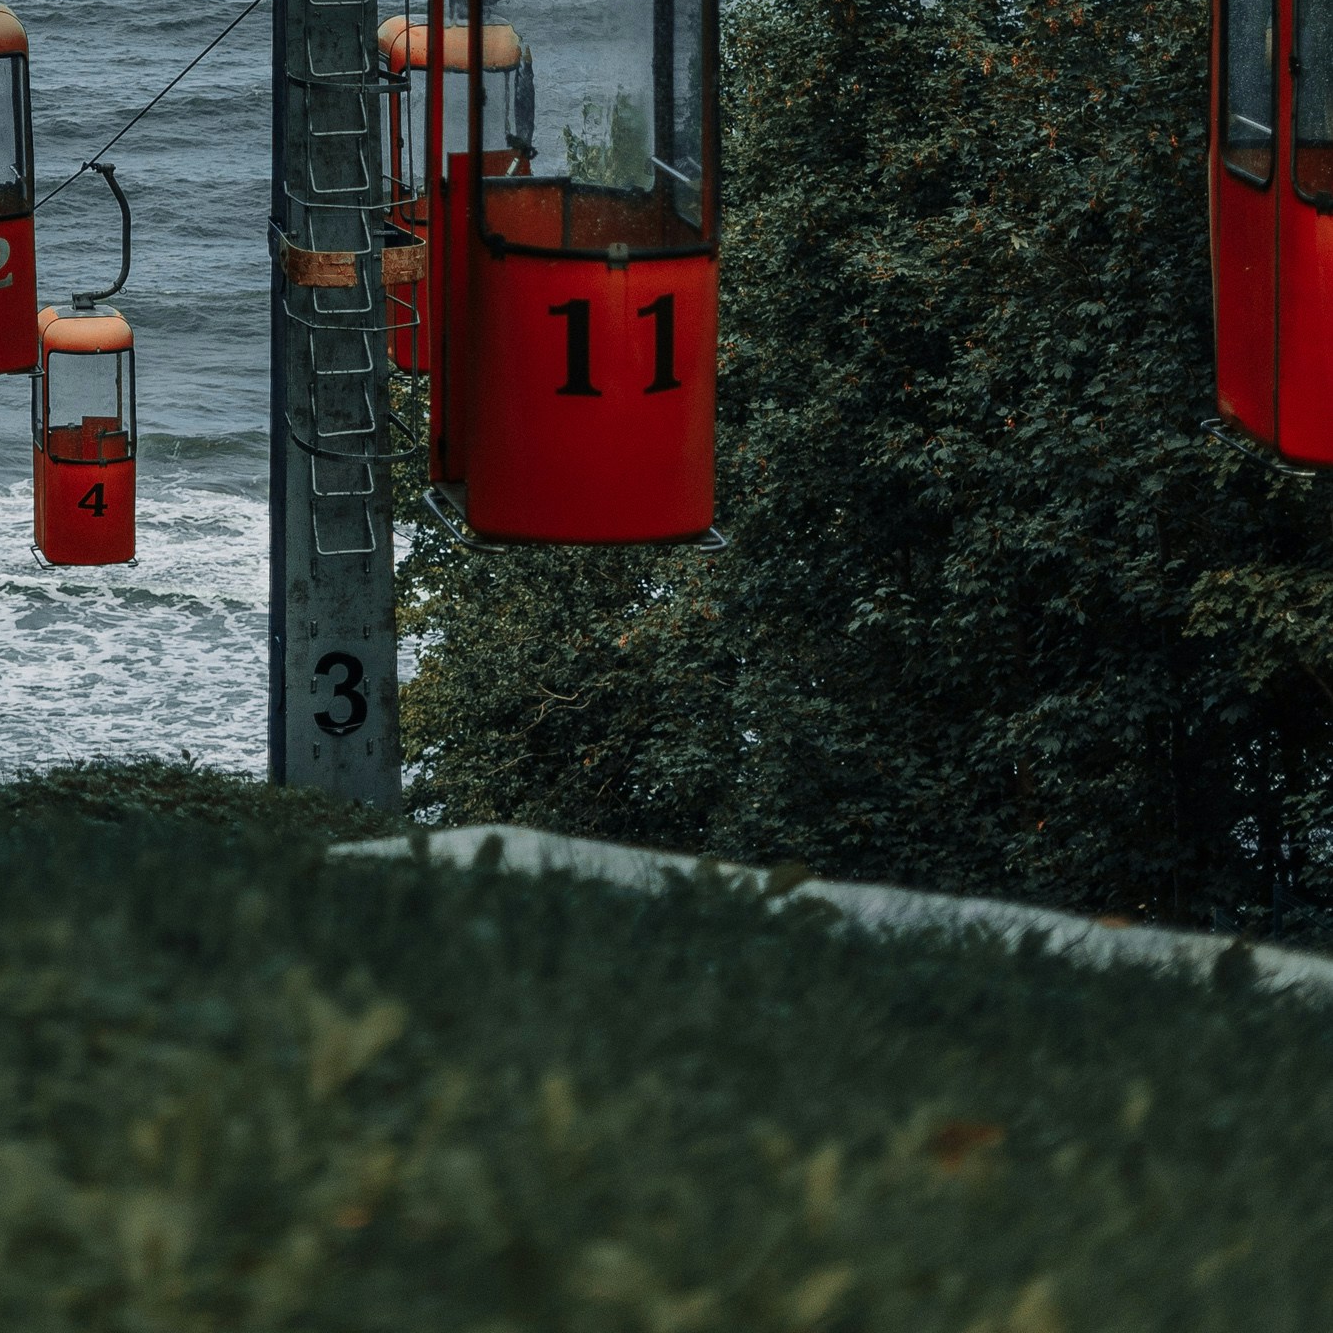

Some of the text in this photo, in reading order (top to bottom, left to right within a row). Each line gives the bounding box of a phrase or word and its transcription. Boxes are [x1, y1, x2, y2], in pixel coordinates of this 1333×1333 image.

[548, 293, 682, 397] 11
[77, 482, 109, 517] 4
[313, 650, 368, 737] 3
